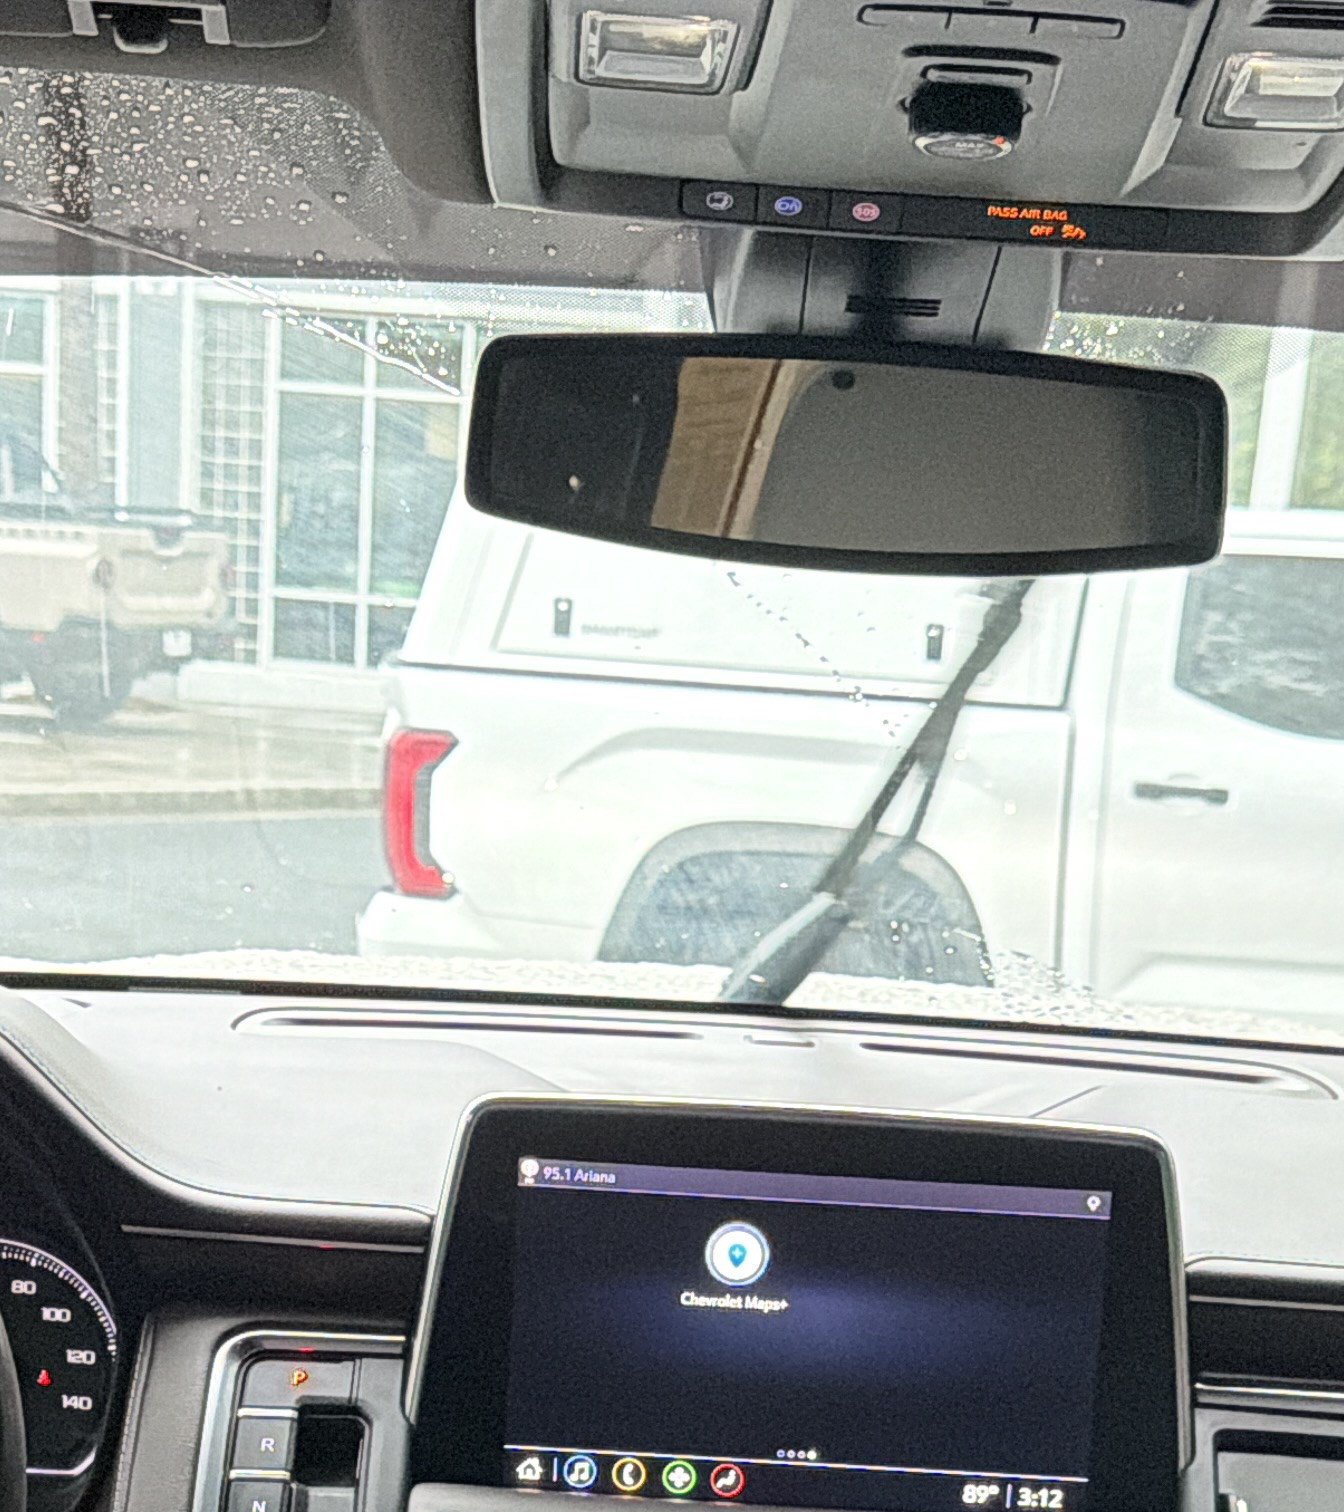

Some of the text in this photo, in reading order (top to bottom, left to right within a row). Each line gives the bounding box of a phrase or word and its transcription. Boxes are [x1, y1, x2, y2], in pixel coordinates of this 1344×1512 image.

[986, 204, 1068, 222] PASS AIR BAG
[1029, 224, 1055, 238] OFF
[543, 1166, 571, 1181] 95.1
[573, 1168, 616, 1184] Ariana
[10, 1279, 37, 1296] 80
[679, 1290, 789, 1314] Chevrolet Maps+
[40, 1306, 72, 1323] 100
[65, 1348, 96, 1366] 120
[289, 1370, 309, 1387] P
[61, 1393, 93, 1411] 140
[259, 1437, 276, 1453] R
[1016, 1486, 1064, 1509] 3:12
